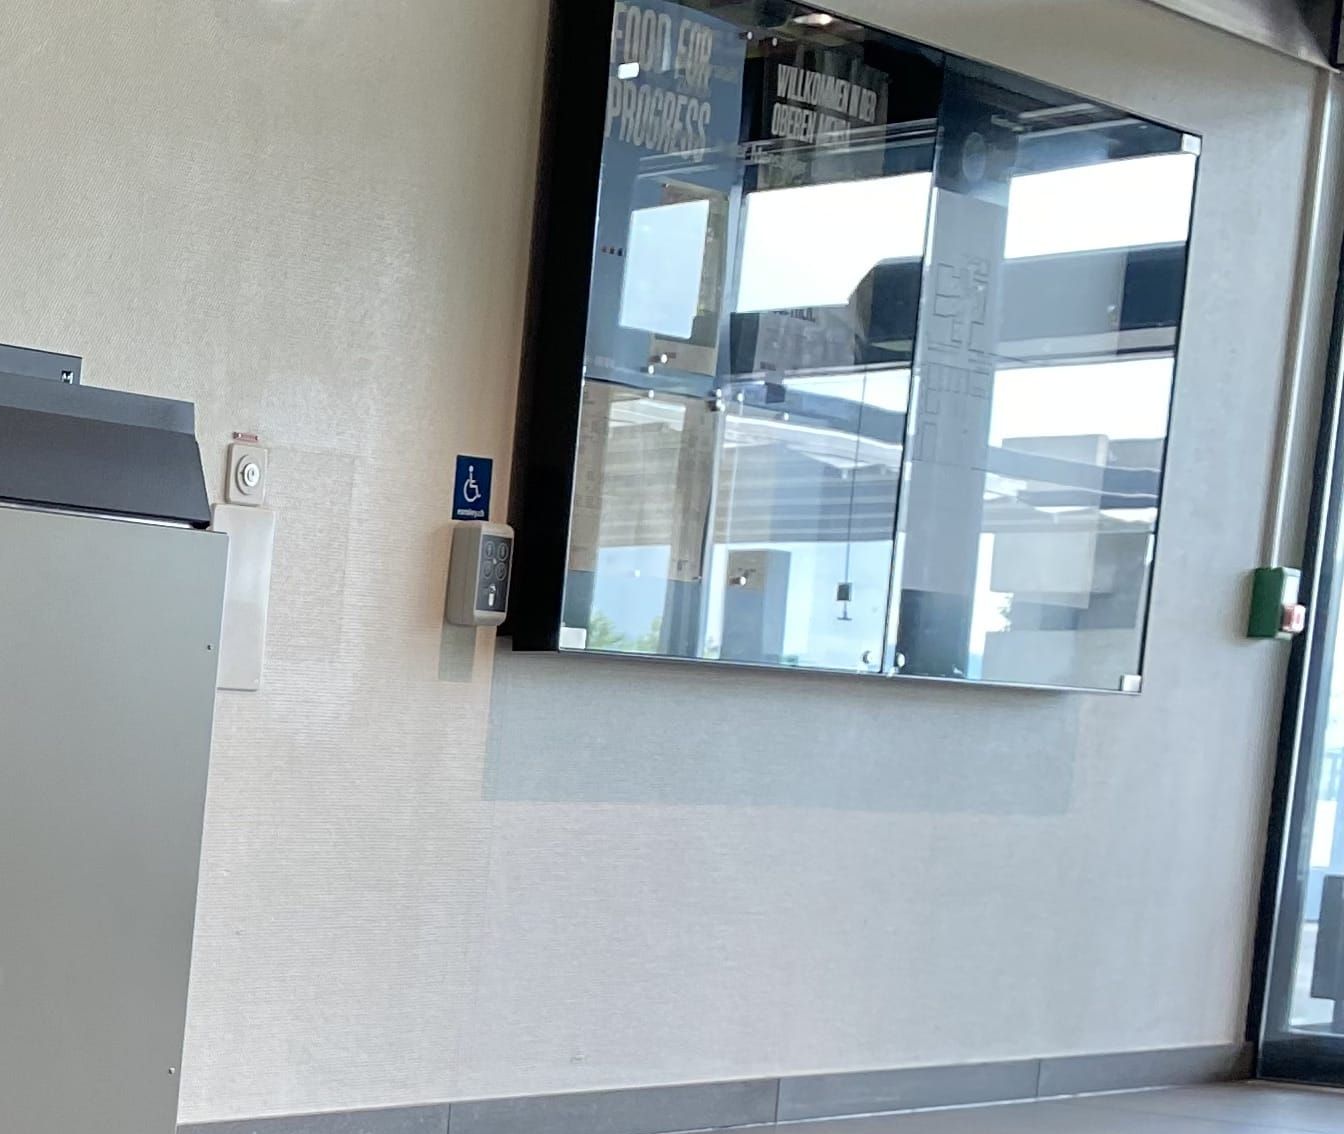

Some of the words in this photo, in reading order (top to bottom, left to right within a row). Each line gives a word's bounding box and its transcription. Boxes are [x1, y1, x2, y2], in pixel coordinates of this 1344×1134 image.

[611, 2, 672, 74] FOOD
[674, 19, 713, 90] FOR
[603, 79, 711, 163] PROGRESS
[777, 63, 850, 114] WILLKOMMEN
[772, 102, 817, 144] OBEREN
